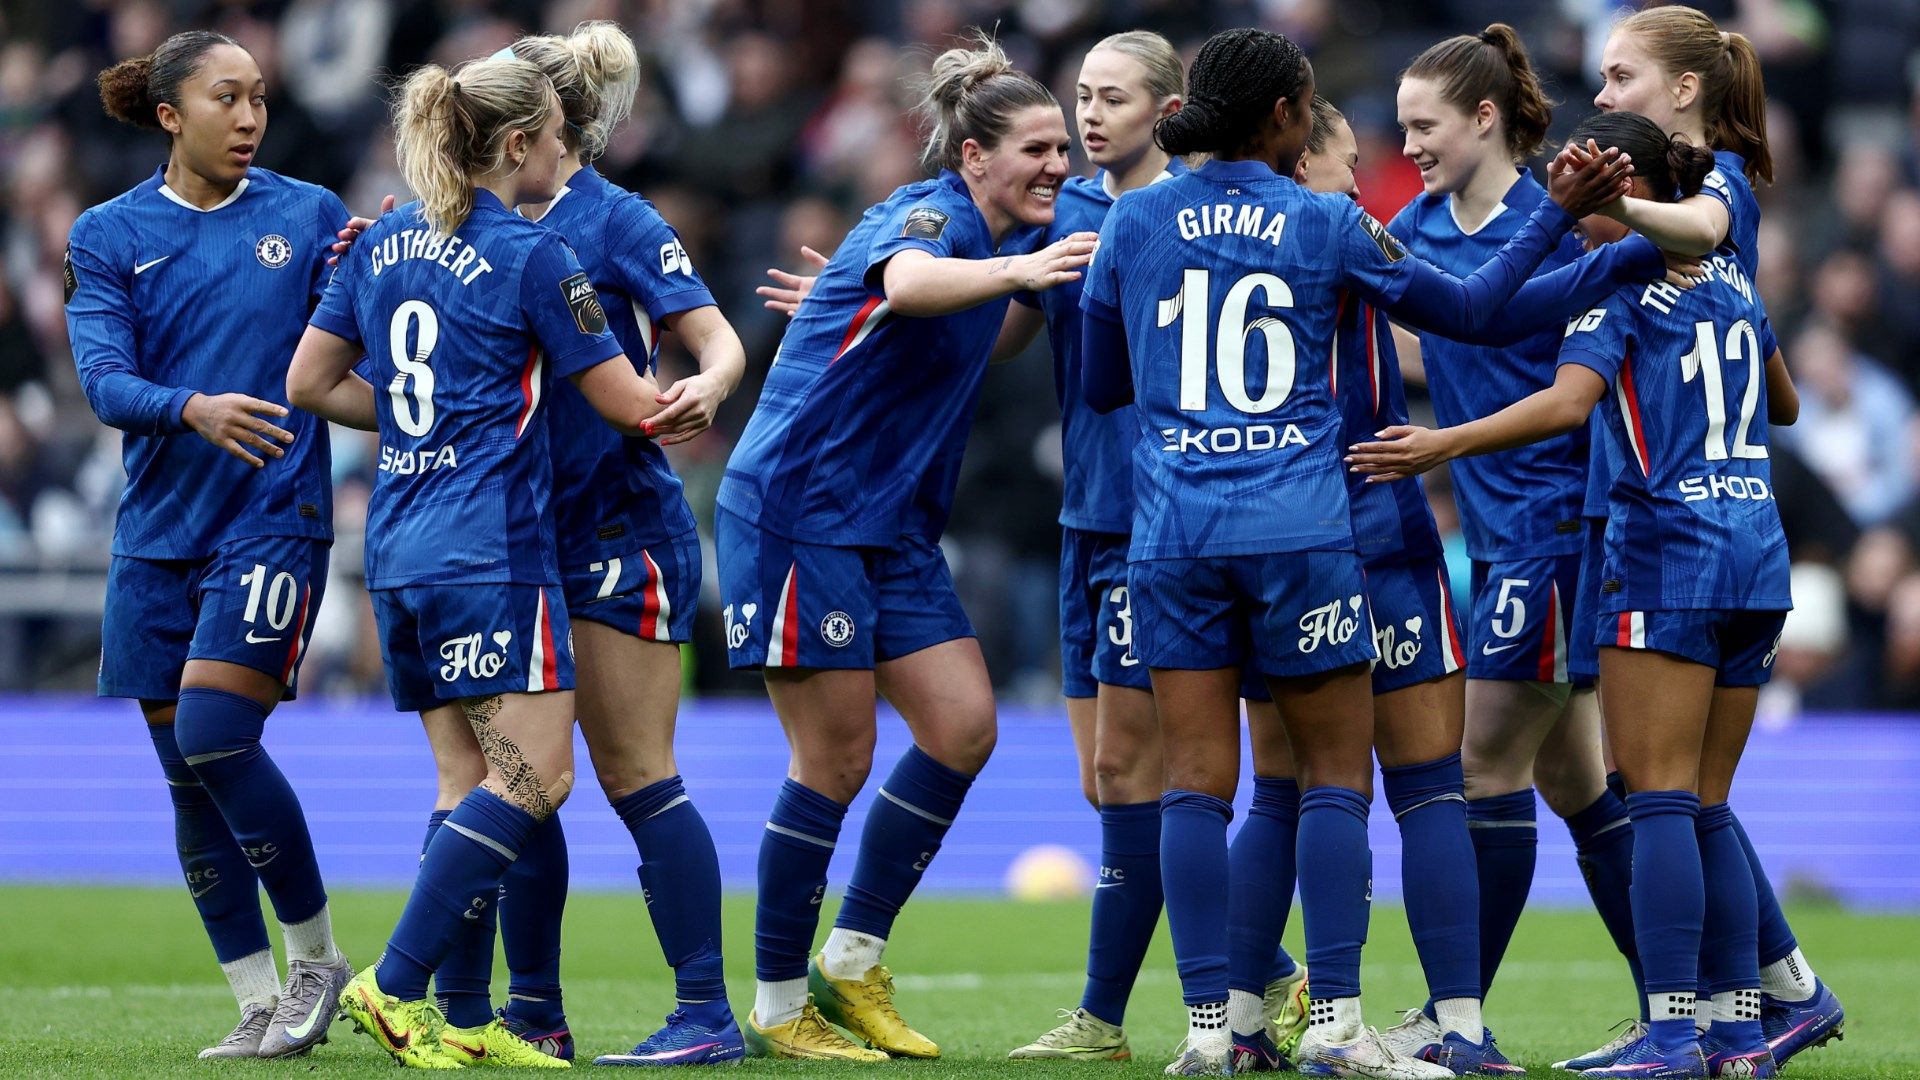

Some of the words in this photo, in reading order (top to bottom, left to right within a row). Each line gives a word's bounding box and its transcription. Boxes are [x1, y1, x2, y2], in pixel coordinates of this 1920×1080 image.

[1177, 204, 1286, 247] GIRMA
[371, 229, 493, 286] CUTHBERT
[1157, 268, 1296, 414] 16
[388, 299, 439, 437] 8
[1680, 319, 1769, 461] 12
[1160, 423, 1310, 454] SKODA
[1679, 474, 1775, 502] SKOD
[240, 564, 297, 631] 10
[590, 557, 622, 600] 7
[1298, 599, 1359, 653] Flo
[1491, 578, 1526, 639] 5
[440, 632, 507, 682] Flo
[1376, 624, 1421, 669] lo
[186, 867, 219, 884] CFC
